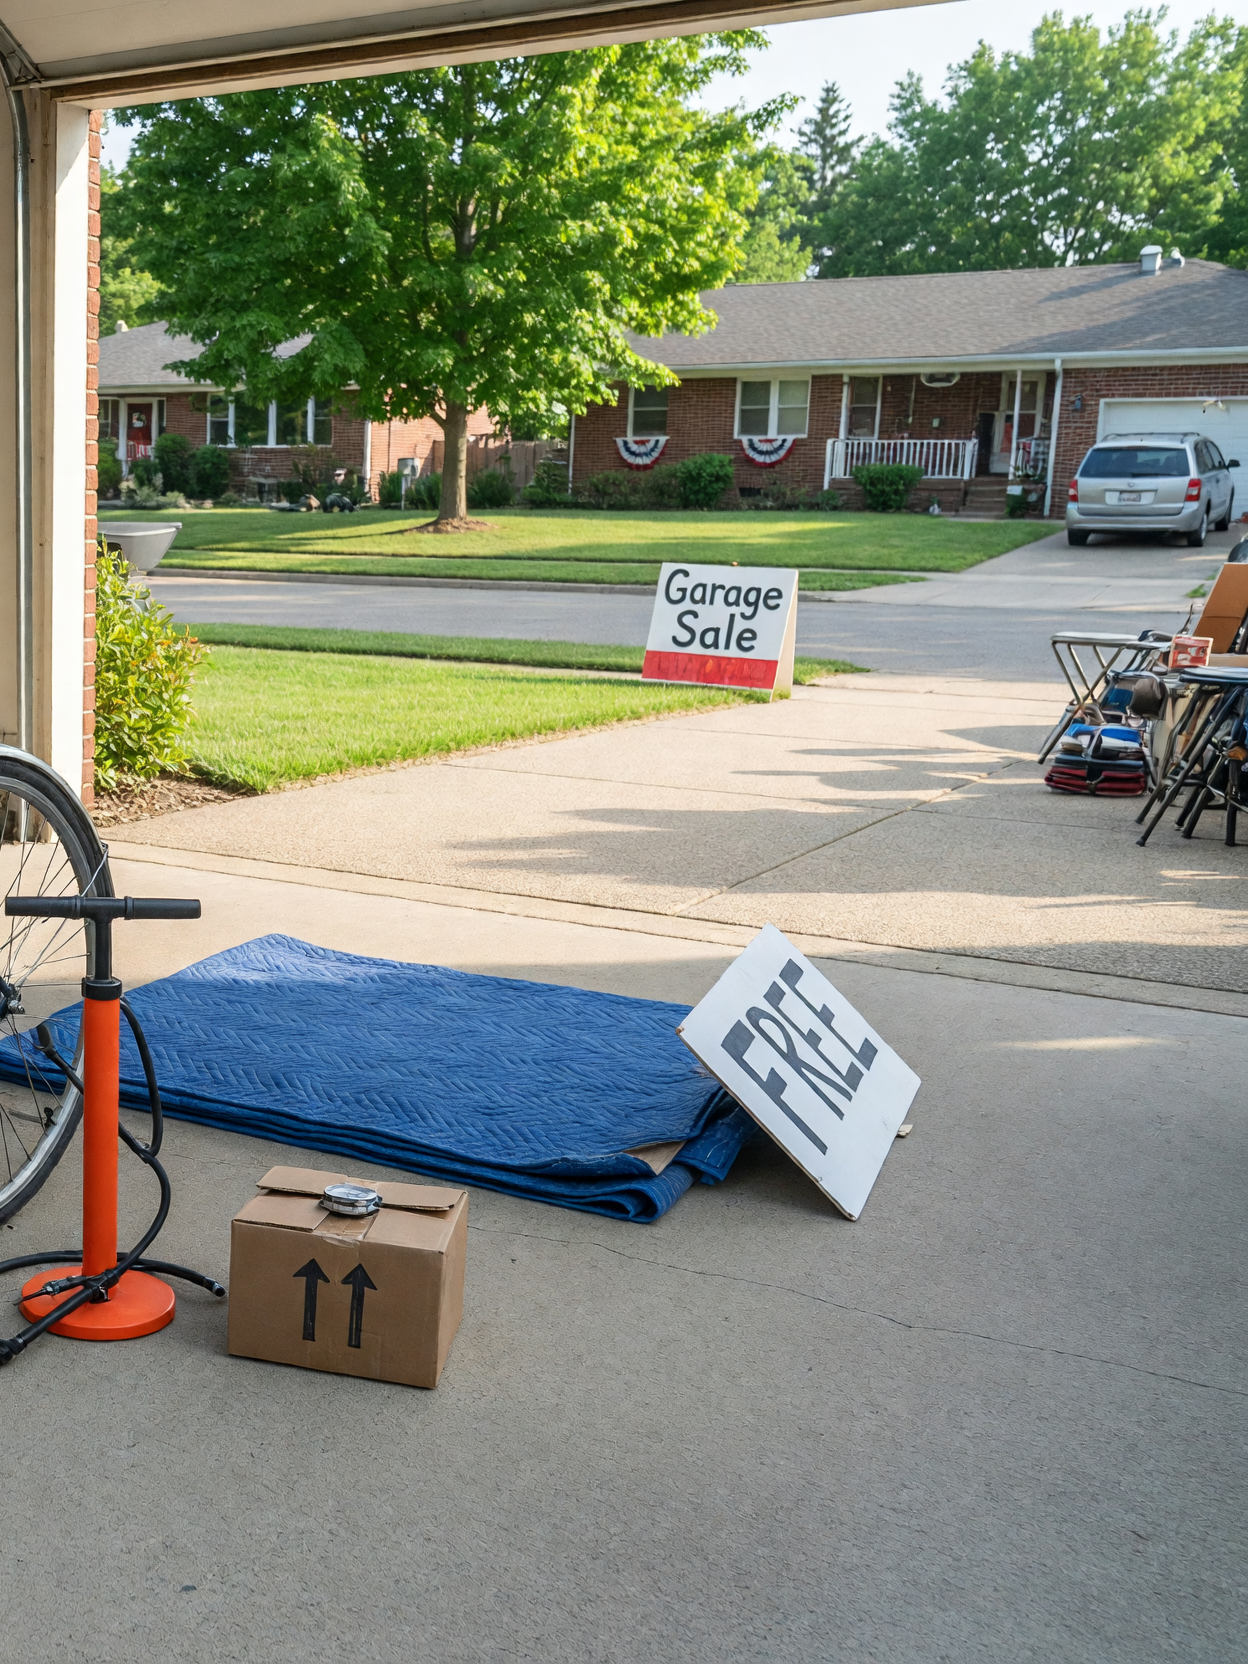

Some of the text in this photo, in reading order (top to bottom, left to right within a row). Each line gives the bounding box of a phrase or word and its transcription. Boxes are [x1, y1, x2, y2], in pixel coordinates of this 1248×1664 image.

[664, 568, 784, 621] Garage
[671, 609, 758, 653] Sale
[720, 958, 879, 1156] FREE
